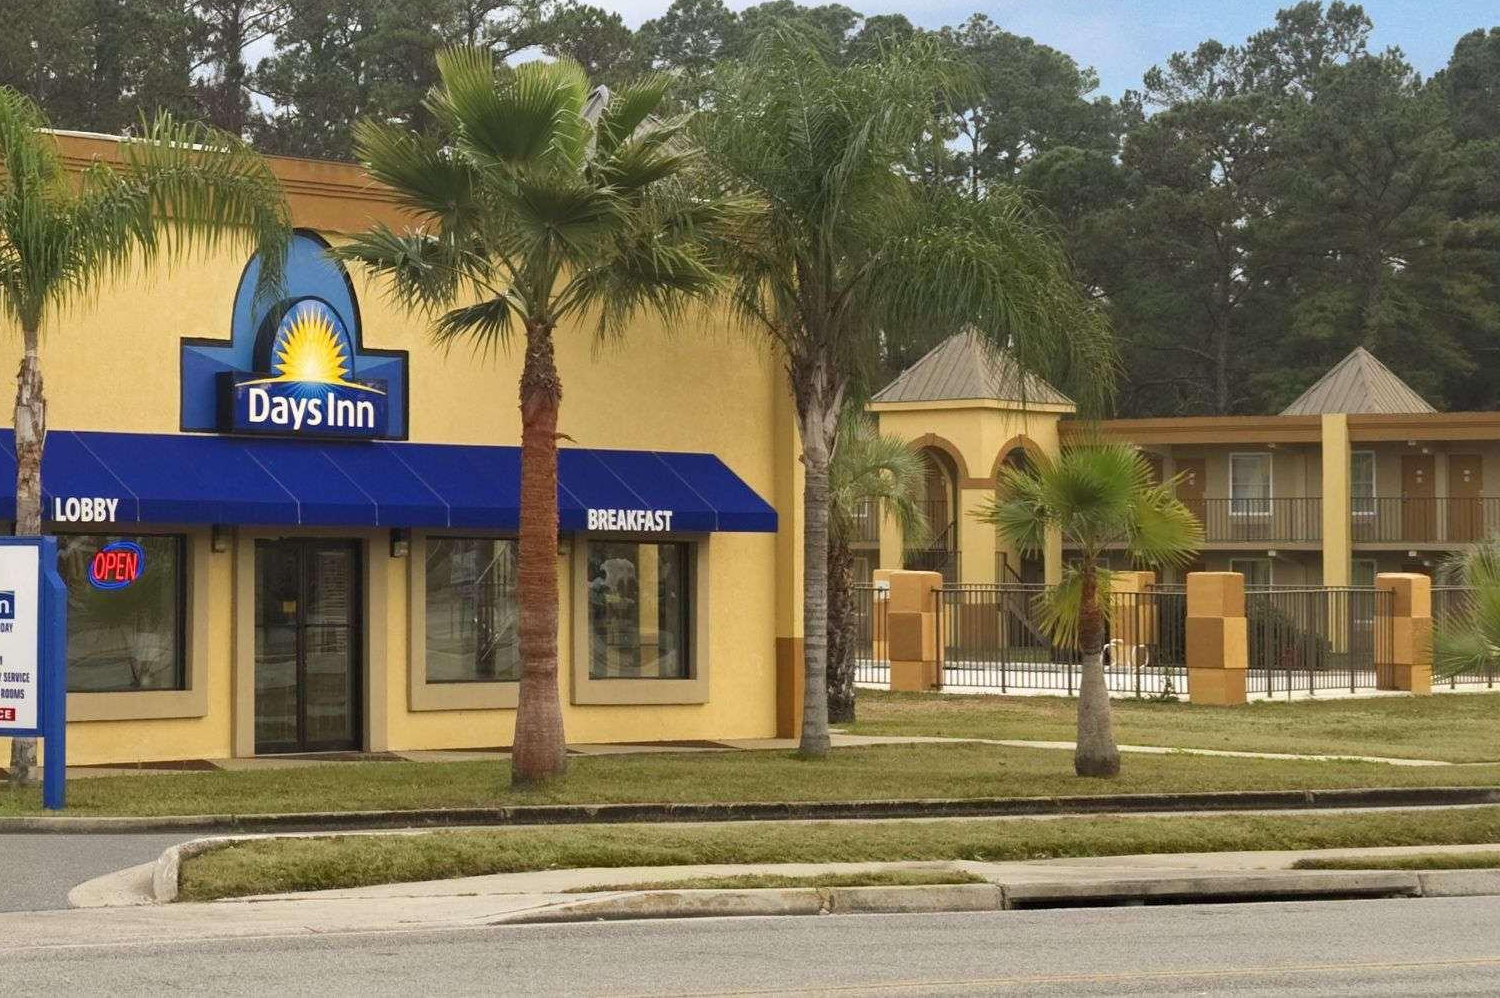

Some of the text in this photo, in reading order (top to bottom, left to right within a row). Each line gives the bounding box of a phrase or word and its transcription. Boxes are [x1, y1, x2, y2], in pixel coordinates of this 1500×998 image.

[249, 388, 374, 430] Days Inn
[55, 497, 119, 522] LOBBY
[587, 508, 673, 531] BREAKFAST
[93, 551, 138, 581] OPEN
[3, 672, 30, 683] SERVICE
[0, 688, 25, 700] ROOMS
